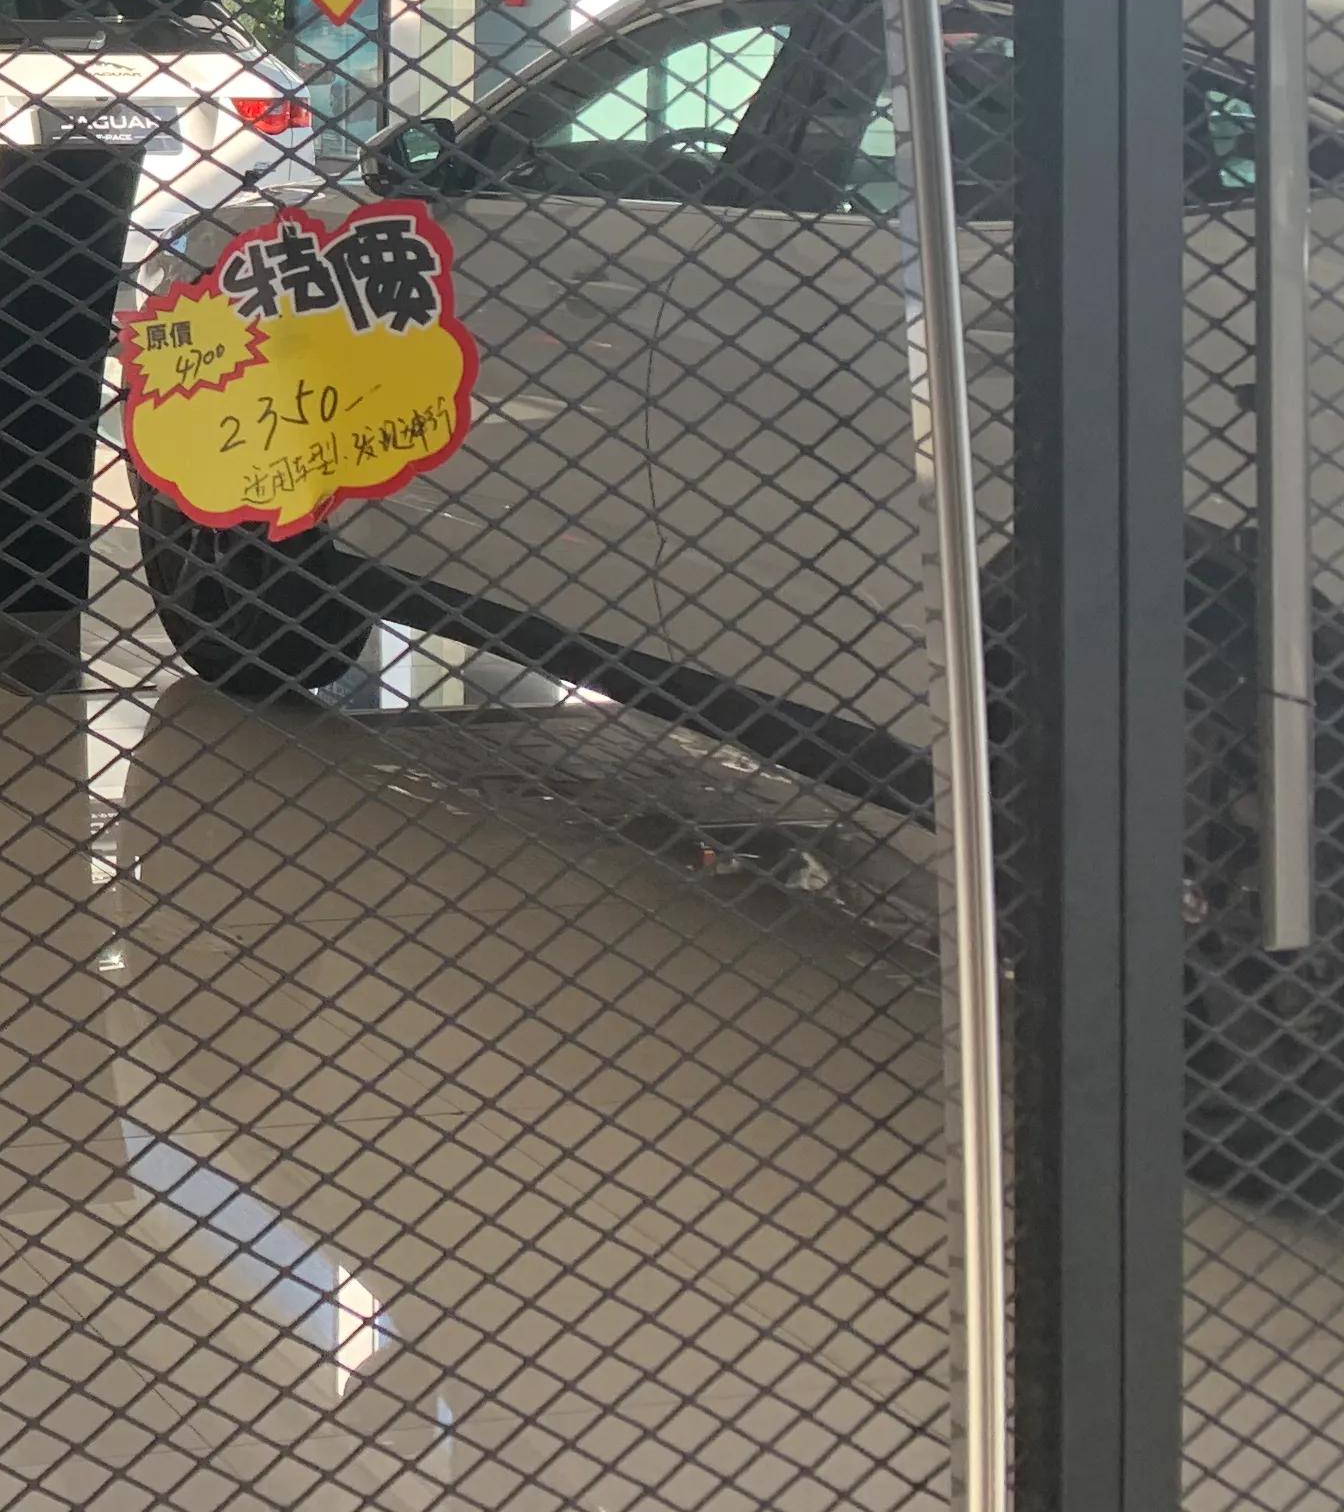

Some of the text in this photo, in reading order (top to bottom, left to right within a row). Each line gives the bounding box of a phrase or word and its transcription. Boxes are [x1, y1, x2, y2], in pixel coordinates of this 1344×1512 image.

[220, 217, 440, 334] 特價
[146, 320, 193, 351] 原價
[176, 343, 225, 383] 4700
